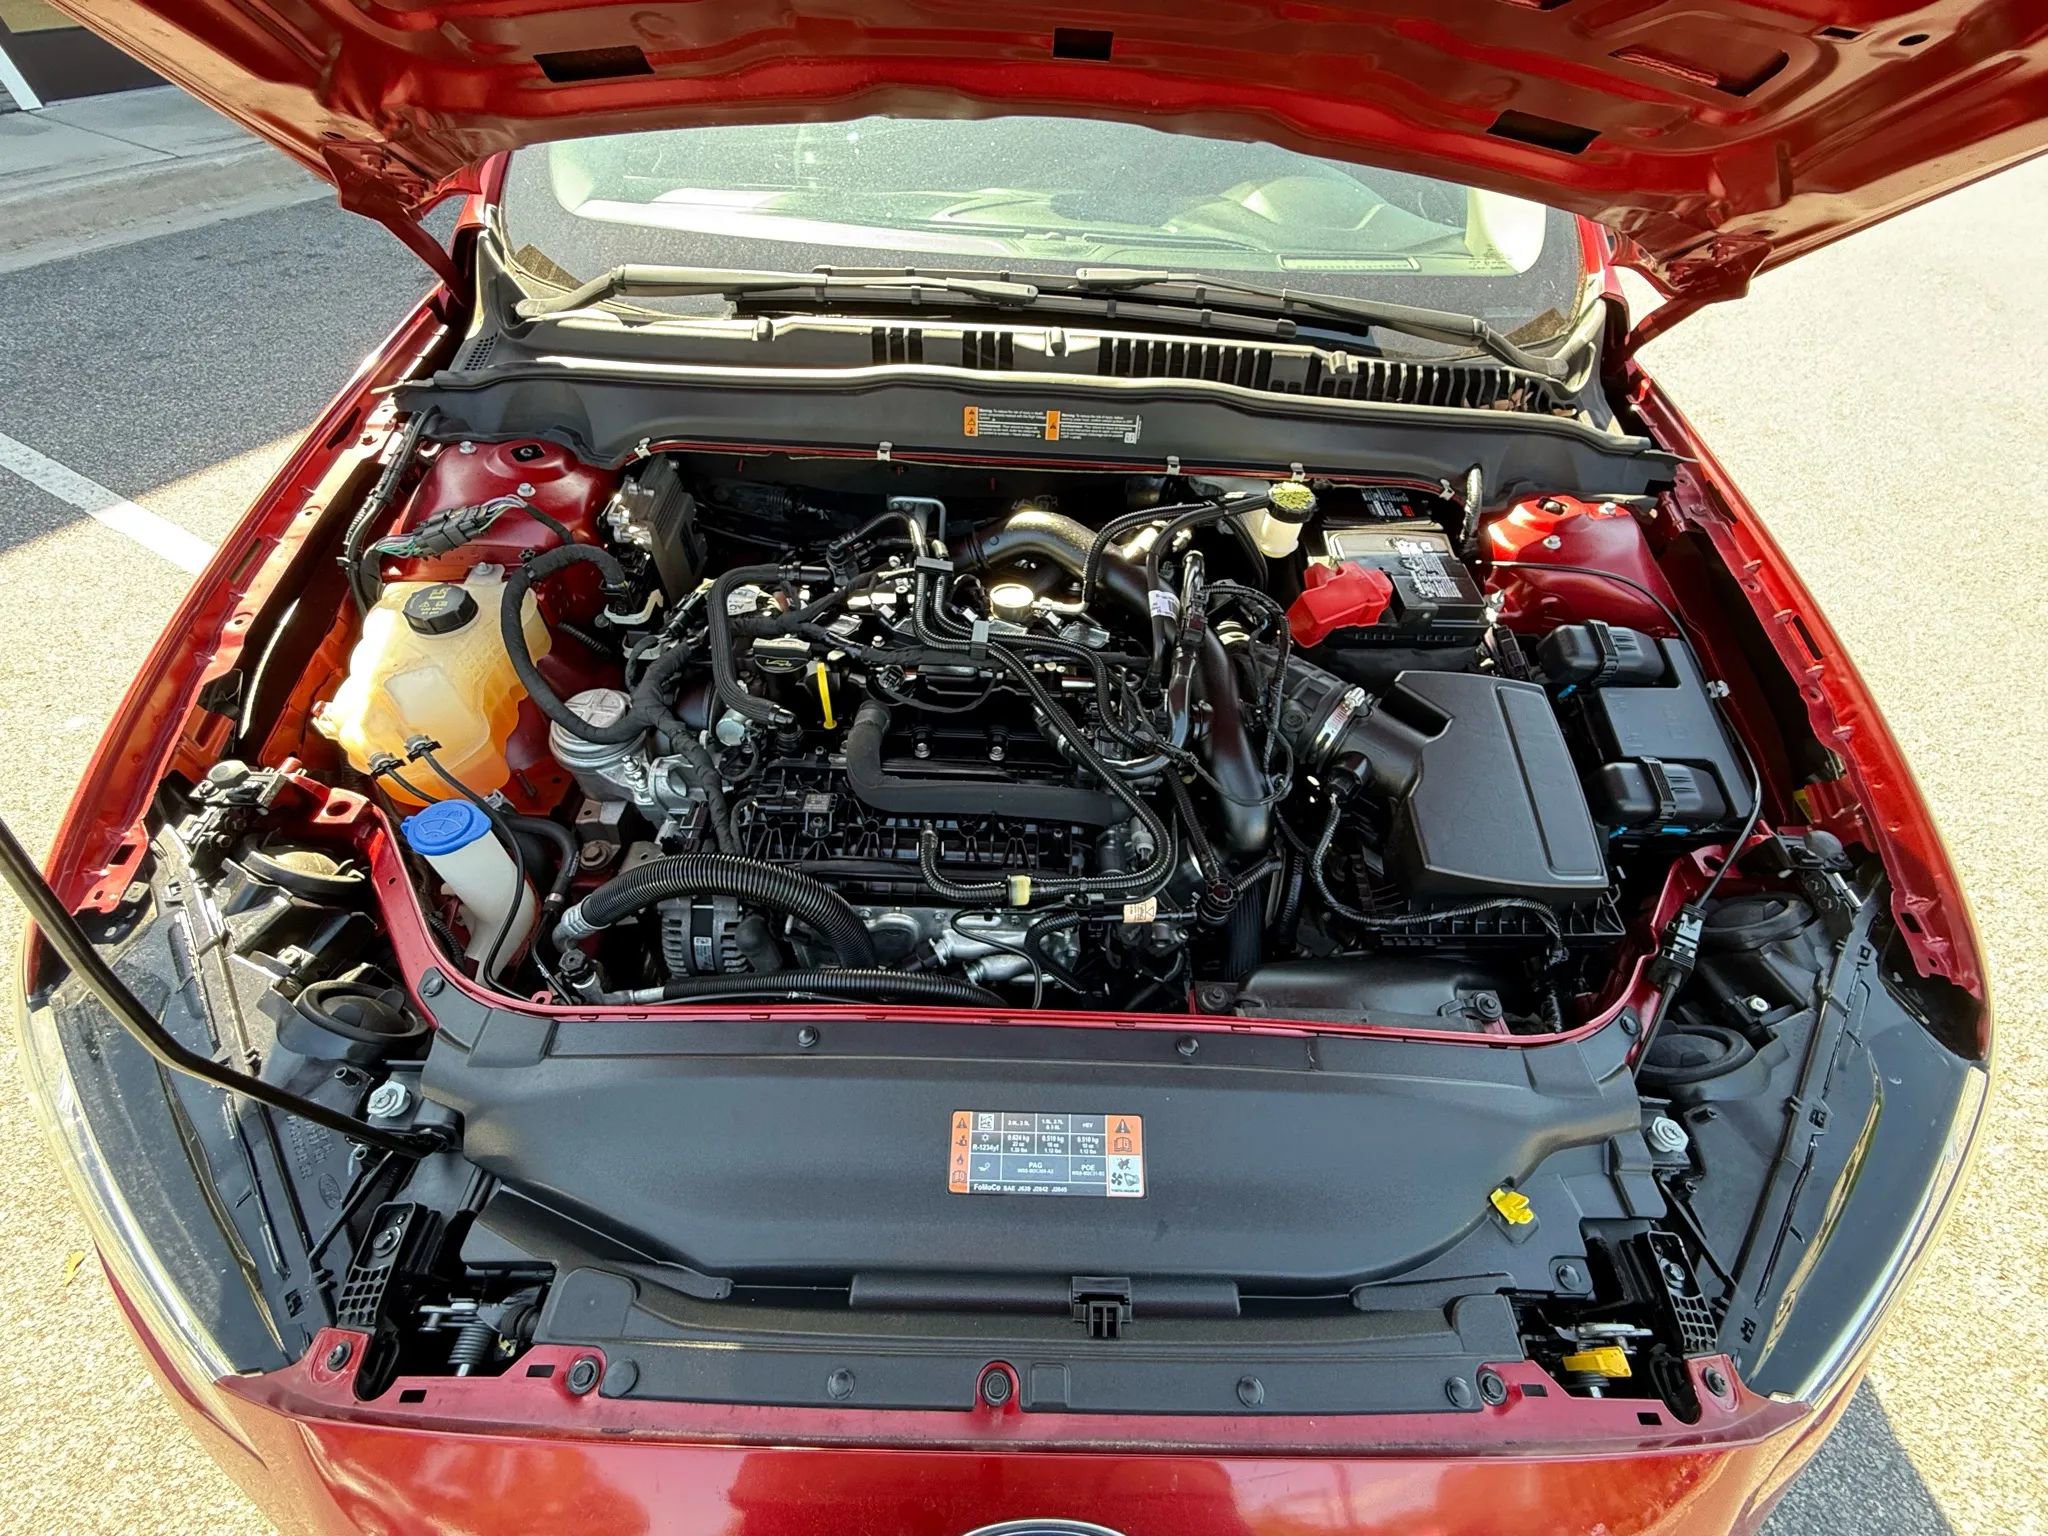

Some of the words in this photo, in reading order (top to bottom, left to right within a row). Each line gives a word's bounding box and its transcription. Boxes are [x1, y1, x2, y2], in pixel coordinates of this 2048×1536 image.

[972, 1143, 1000, 1153] R-1234yf
[1028, 1161, 1043, 1169] PAG
[973, 1183, 1001, 1192] FoMoCo
